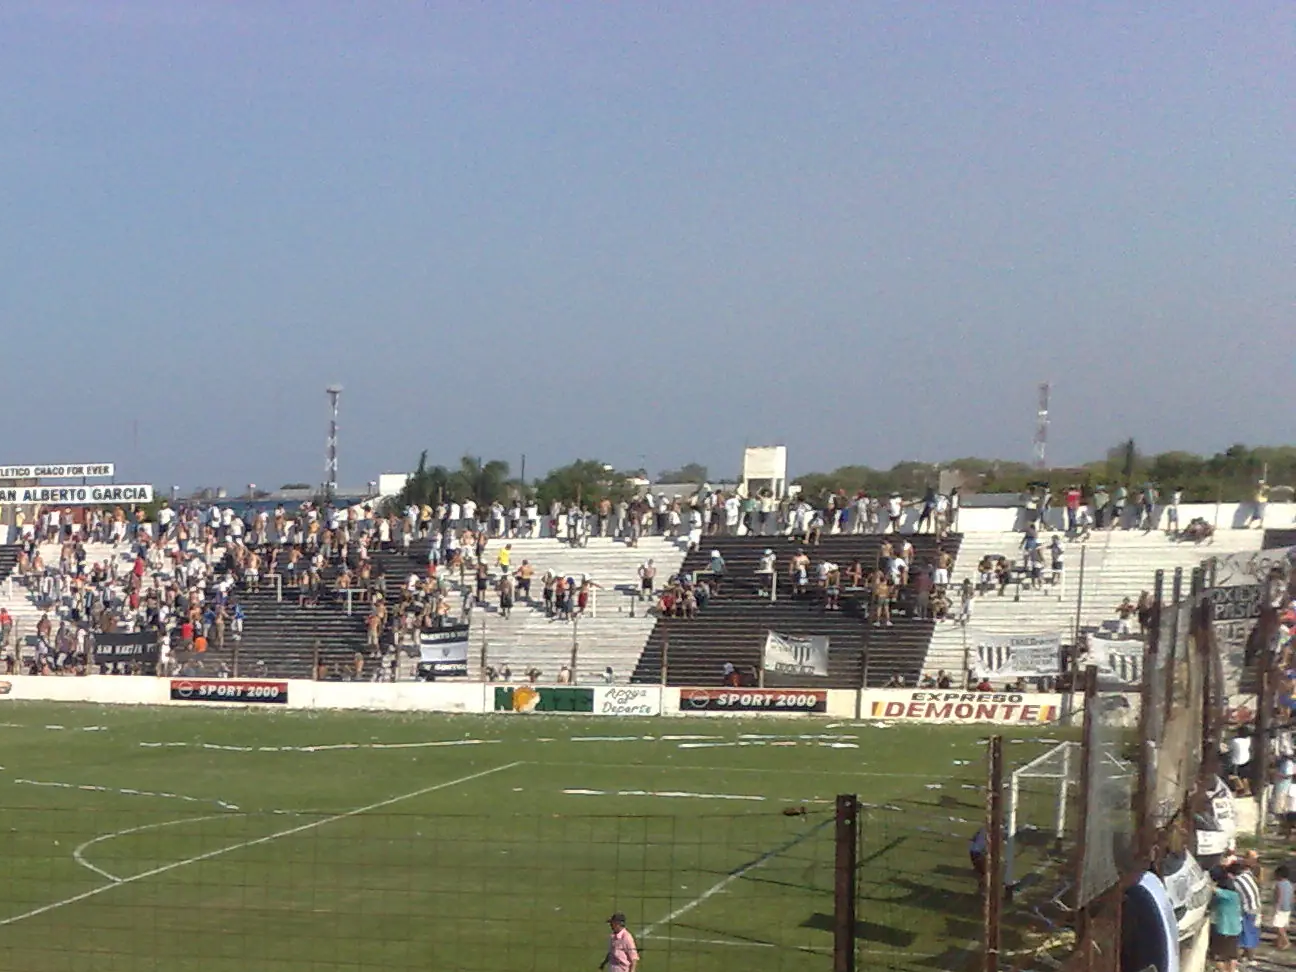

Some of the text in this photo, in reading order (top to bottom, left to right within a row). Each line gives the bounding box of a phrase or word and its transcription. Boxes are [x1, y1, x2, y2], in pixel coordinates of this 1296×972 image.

[34, 467, 64, 476] CHACO
[67, 466, 84, 475] FOR
[87, 465, 110, 475] EVER
[23, 488, 86, 502] ALBERTO
[92, 487, 148, 500] GARCIA
[198, 684, 279, 697] SPORT 2000
[911, 691, 1023, 703] EXPRESO
[716, 693, 817, 707] SPORT 2000
[884, 701, 1039, 719] DEMONTE
